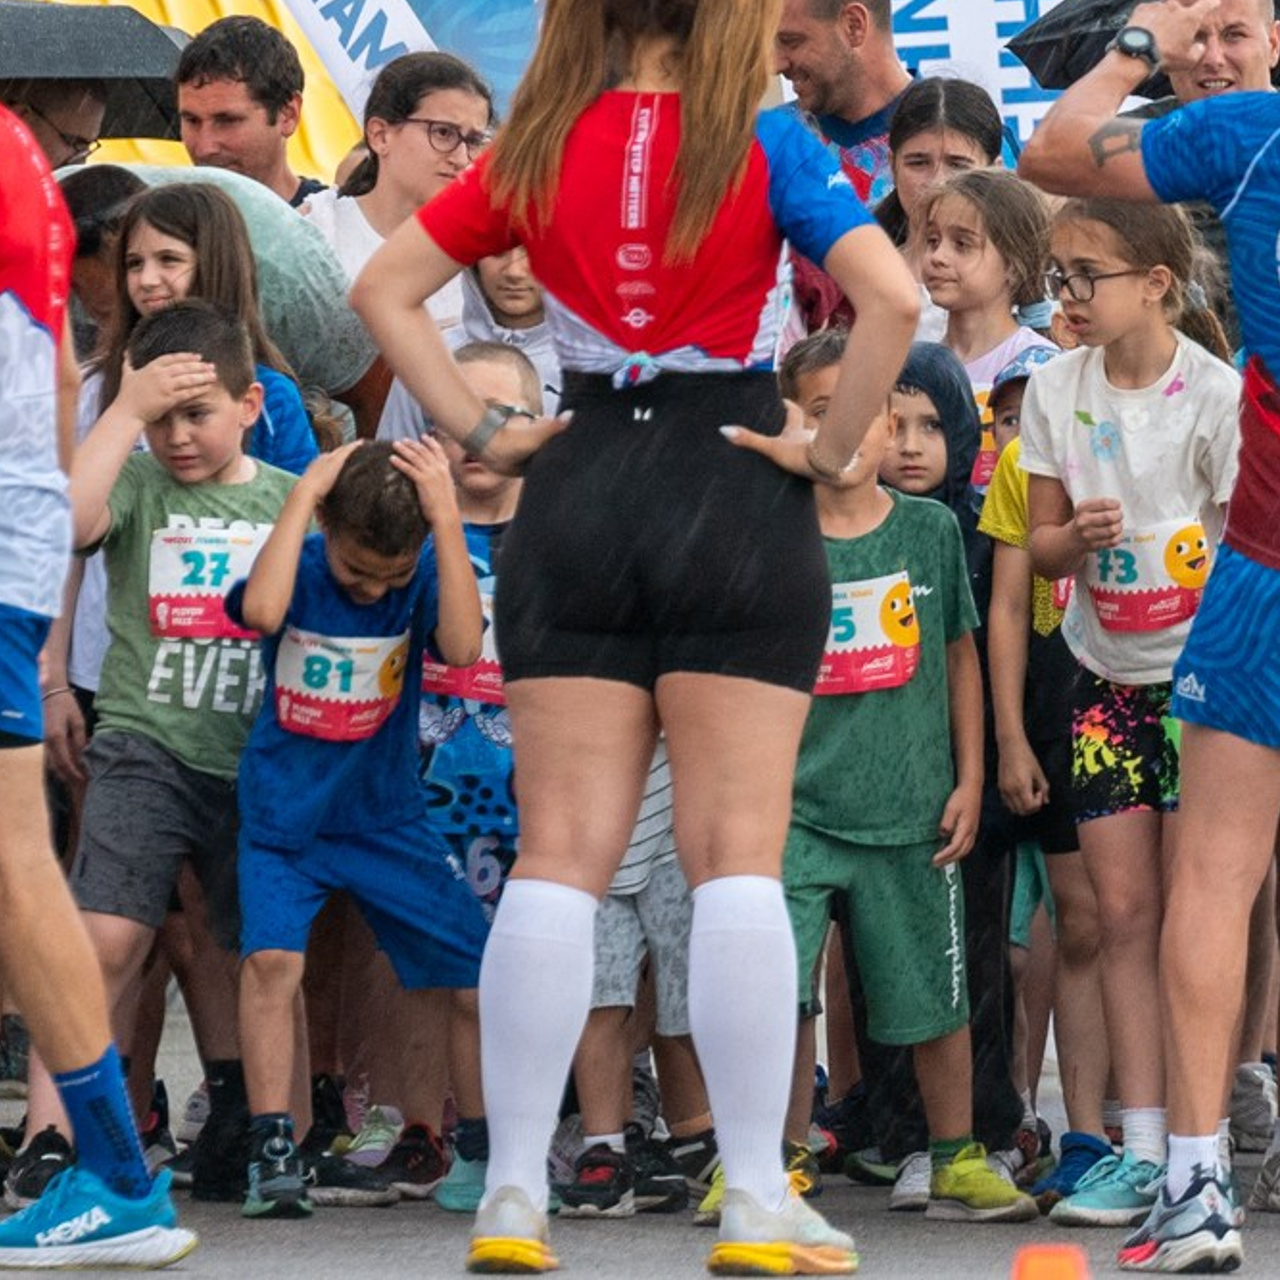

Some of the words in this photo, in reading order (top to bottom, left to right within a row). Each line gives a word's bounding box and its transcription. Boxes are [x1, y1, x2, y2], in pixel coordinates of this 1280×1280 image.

[181, 550, 231, 587] 27
[302, 655, 354, 693] 81
[35, 1205, 112, 1247] HOKA
